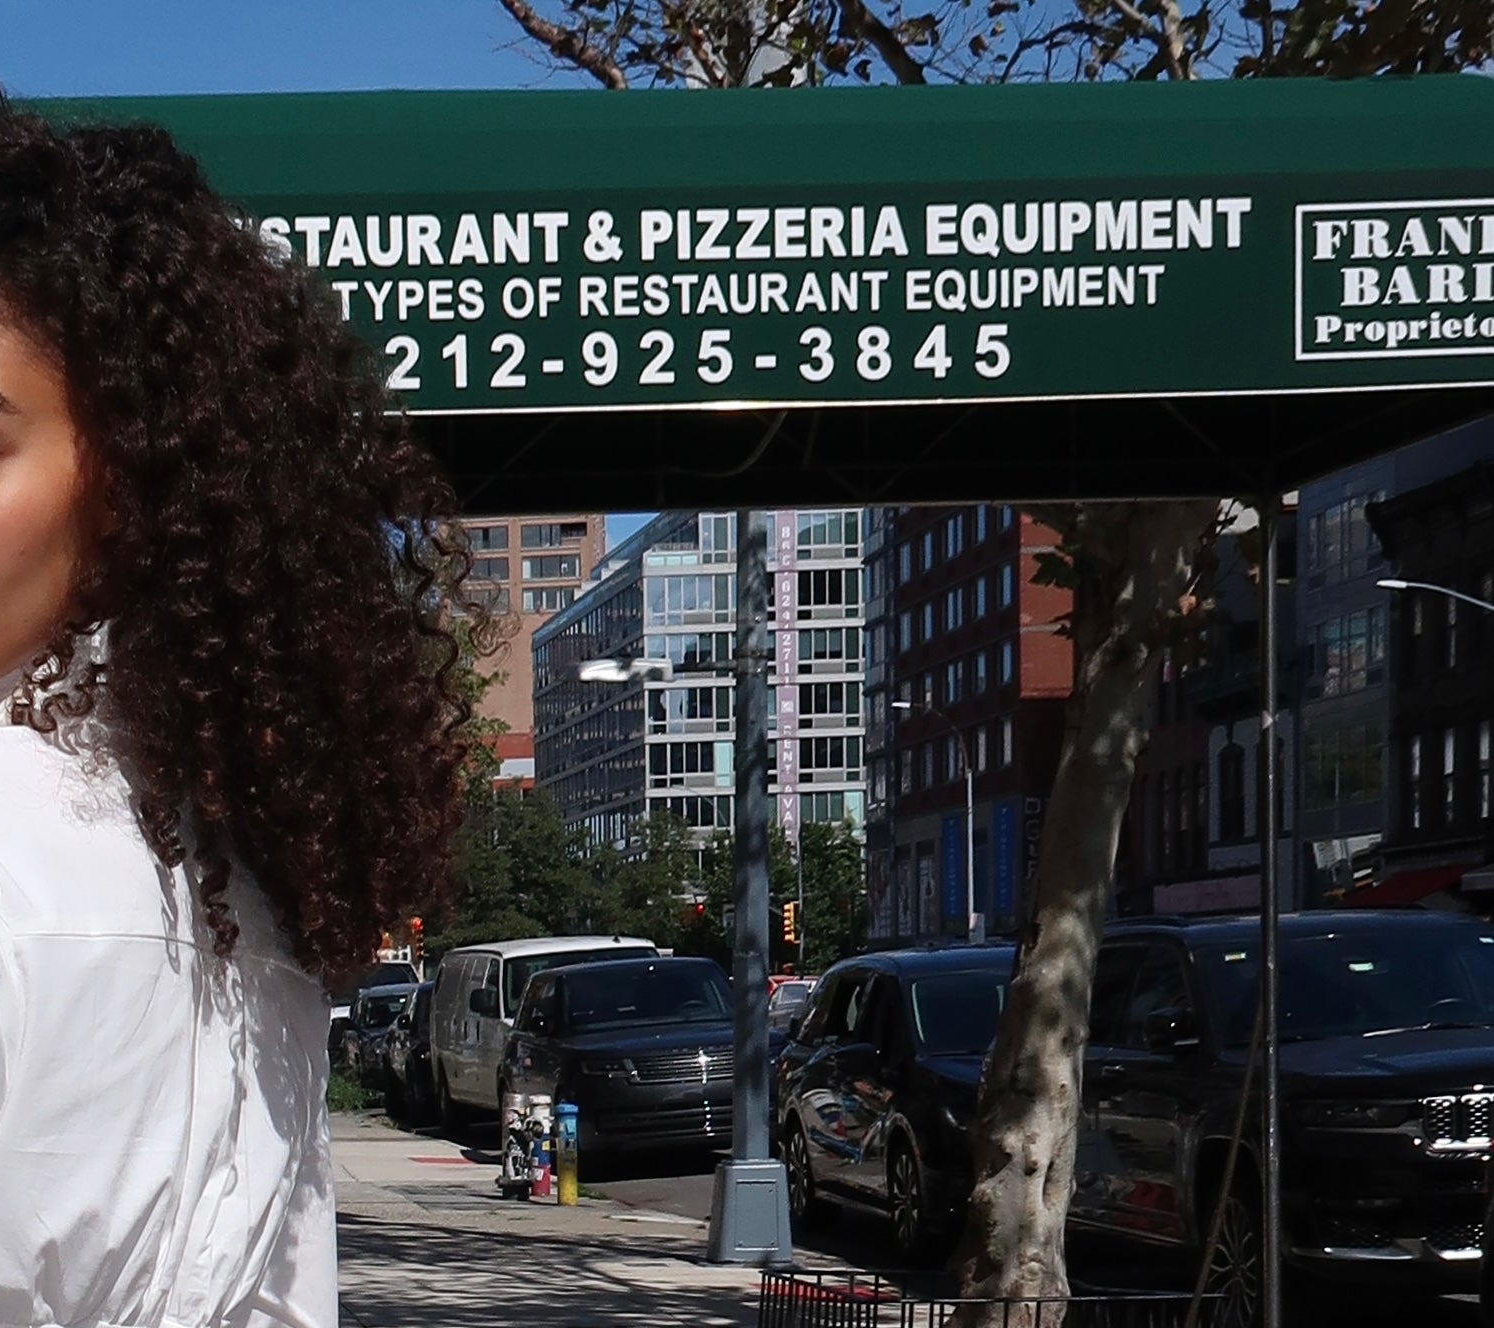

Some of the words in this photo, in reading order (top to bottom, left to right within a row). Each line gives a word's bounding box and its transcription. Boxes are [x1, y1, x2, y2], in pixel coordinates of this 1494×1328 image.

[234, 208, 570, 269] STAURANT
[583, 210, 623, 262] &
[640, 203, 907, 261] PIZZERIA
[926, 197, 1252, 257] EQUIPMENT
[331, 278, 485, 321] TYPES
[502, 277, 562, 319] OF
[580, 271, 890, 317] RESTAURANT
[906, 265, 1166, 312] EQUIPMENT
[1340, 262, 1494, 306] BARI
